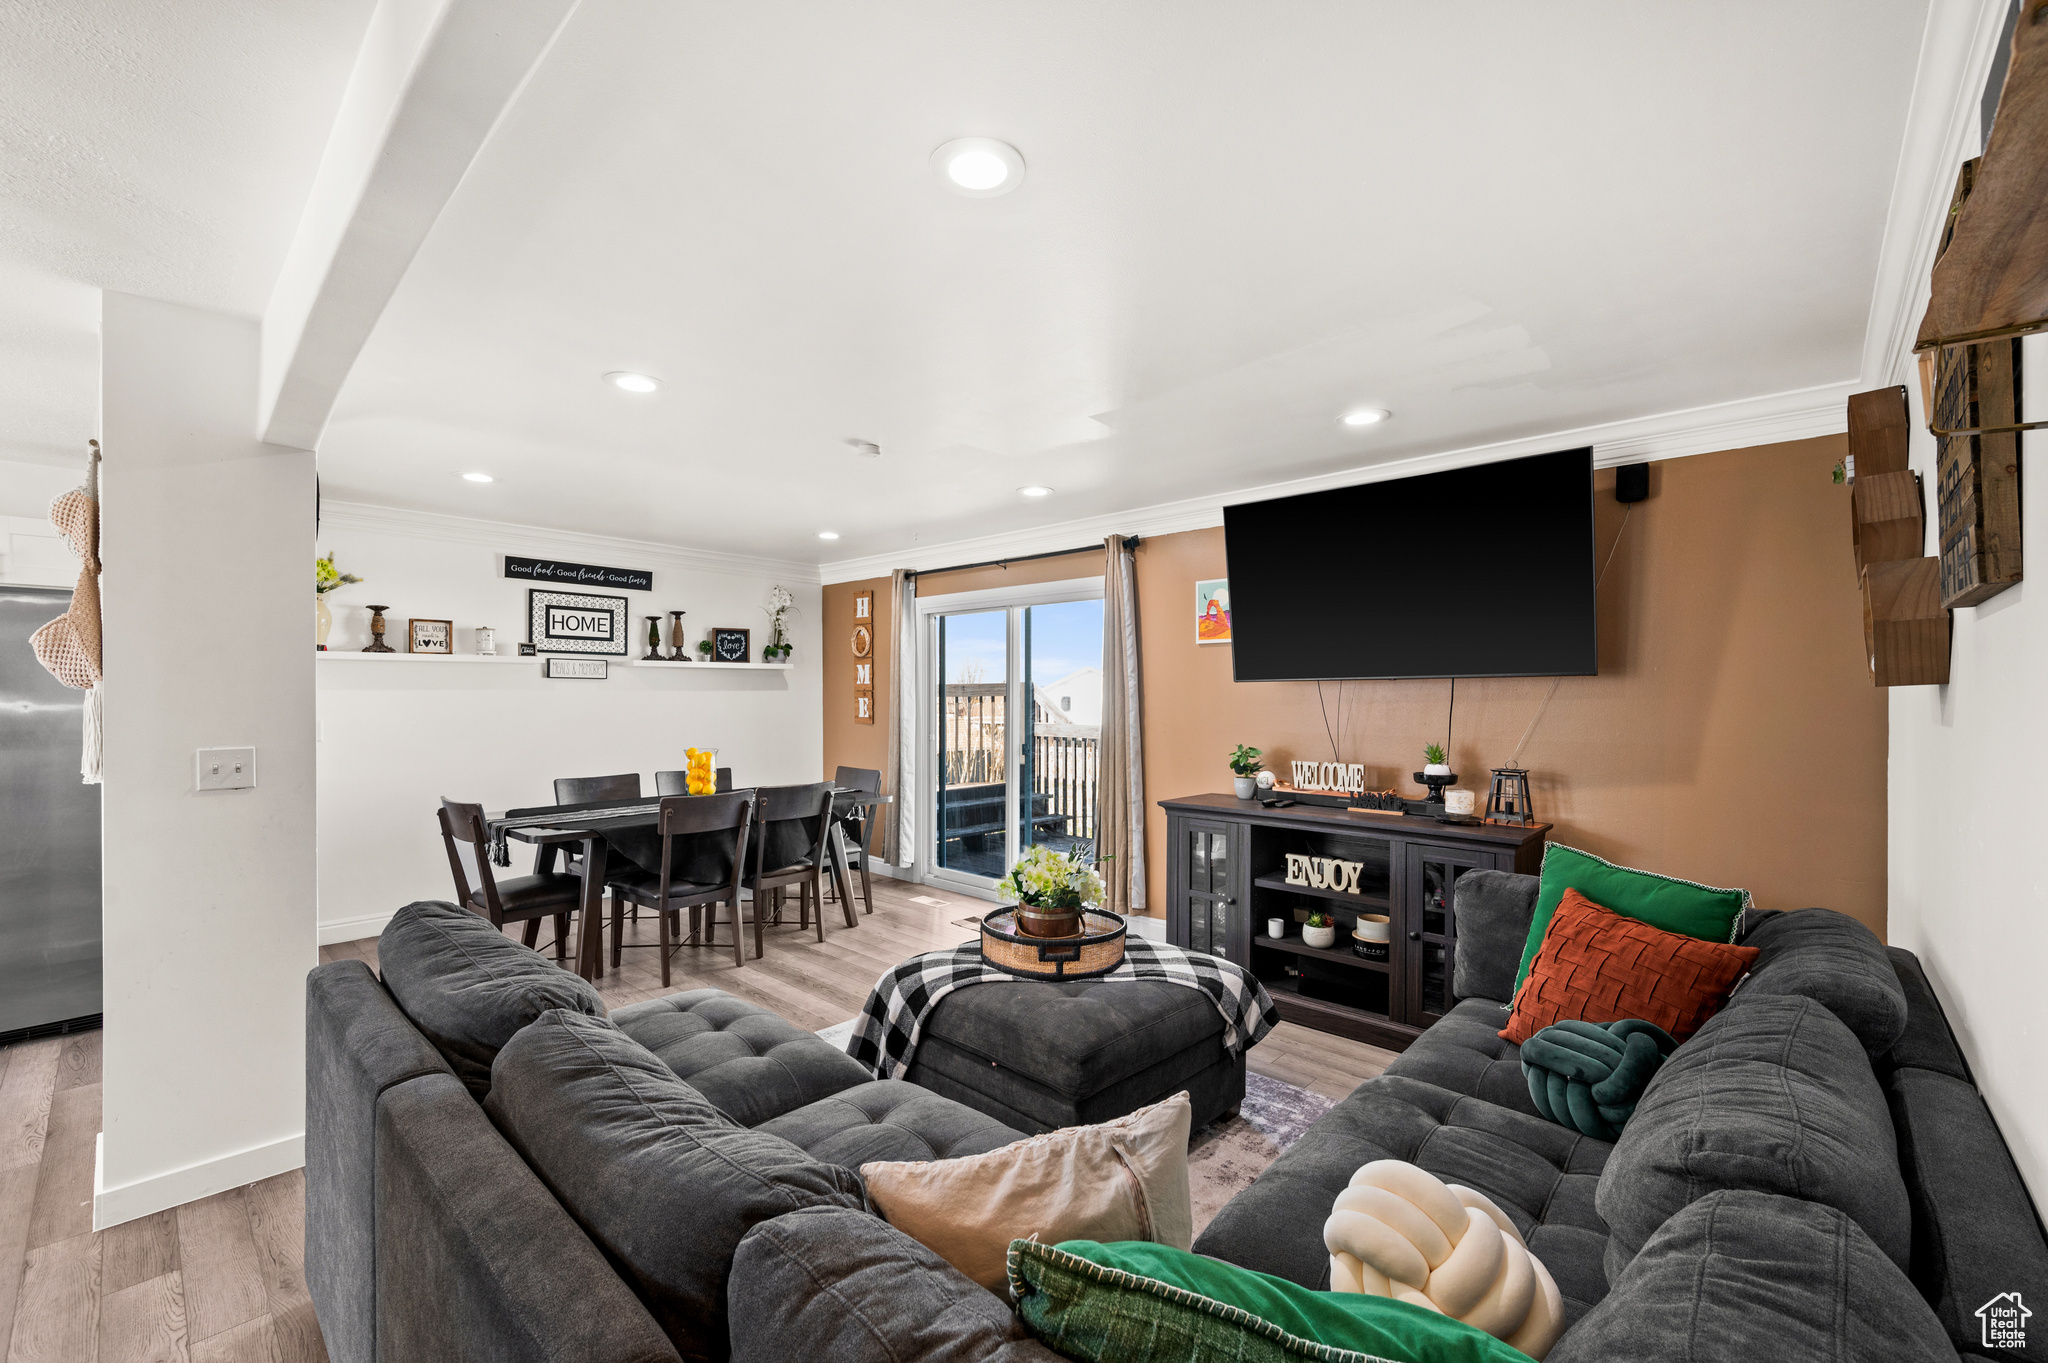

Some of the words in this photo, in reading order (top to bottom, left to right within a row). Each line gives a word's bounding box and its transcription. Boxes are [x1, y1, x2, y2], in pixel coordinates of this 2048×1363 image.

[510, 564, 532, 573] Good
[533, 563, 555, 577] food
[557, 569, 577, 578] Good
[578, 567, 606, 581] friends
[609, 574, 628, 583] Good
[628, 575, 647, 585] times
[431, 625, 444, 633] YOU
[552, 614, 609, 633] HOME
[723, 640, 740, 650] love
[552, 662, 571, 675] MEALS
[571, 662, 577, 675] &
[1291, 760, 1365, 793] WELCOME
[1285, 853, 1365, 895] ENJOY
